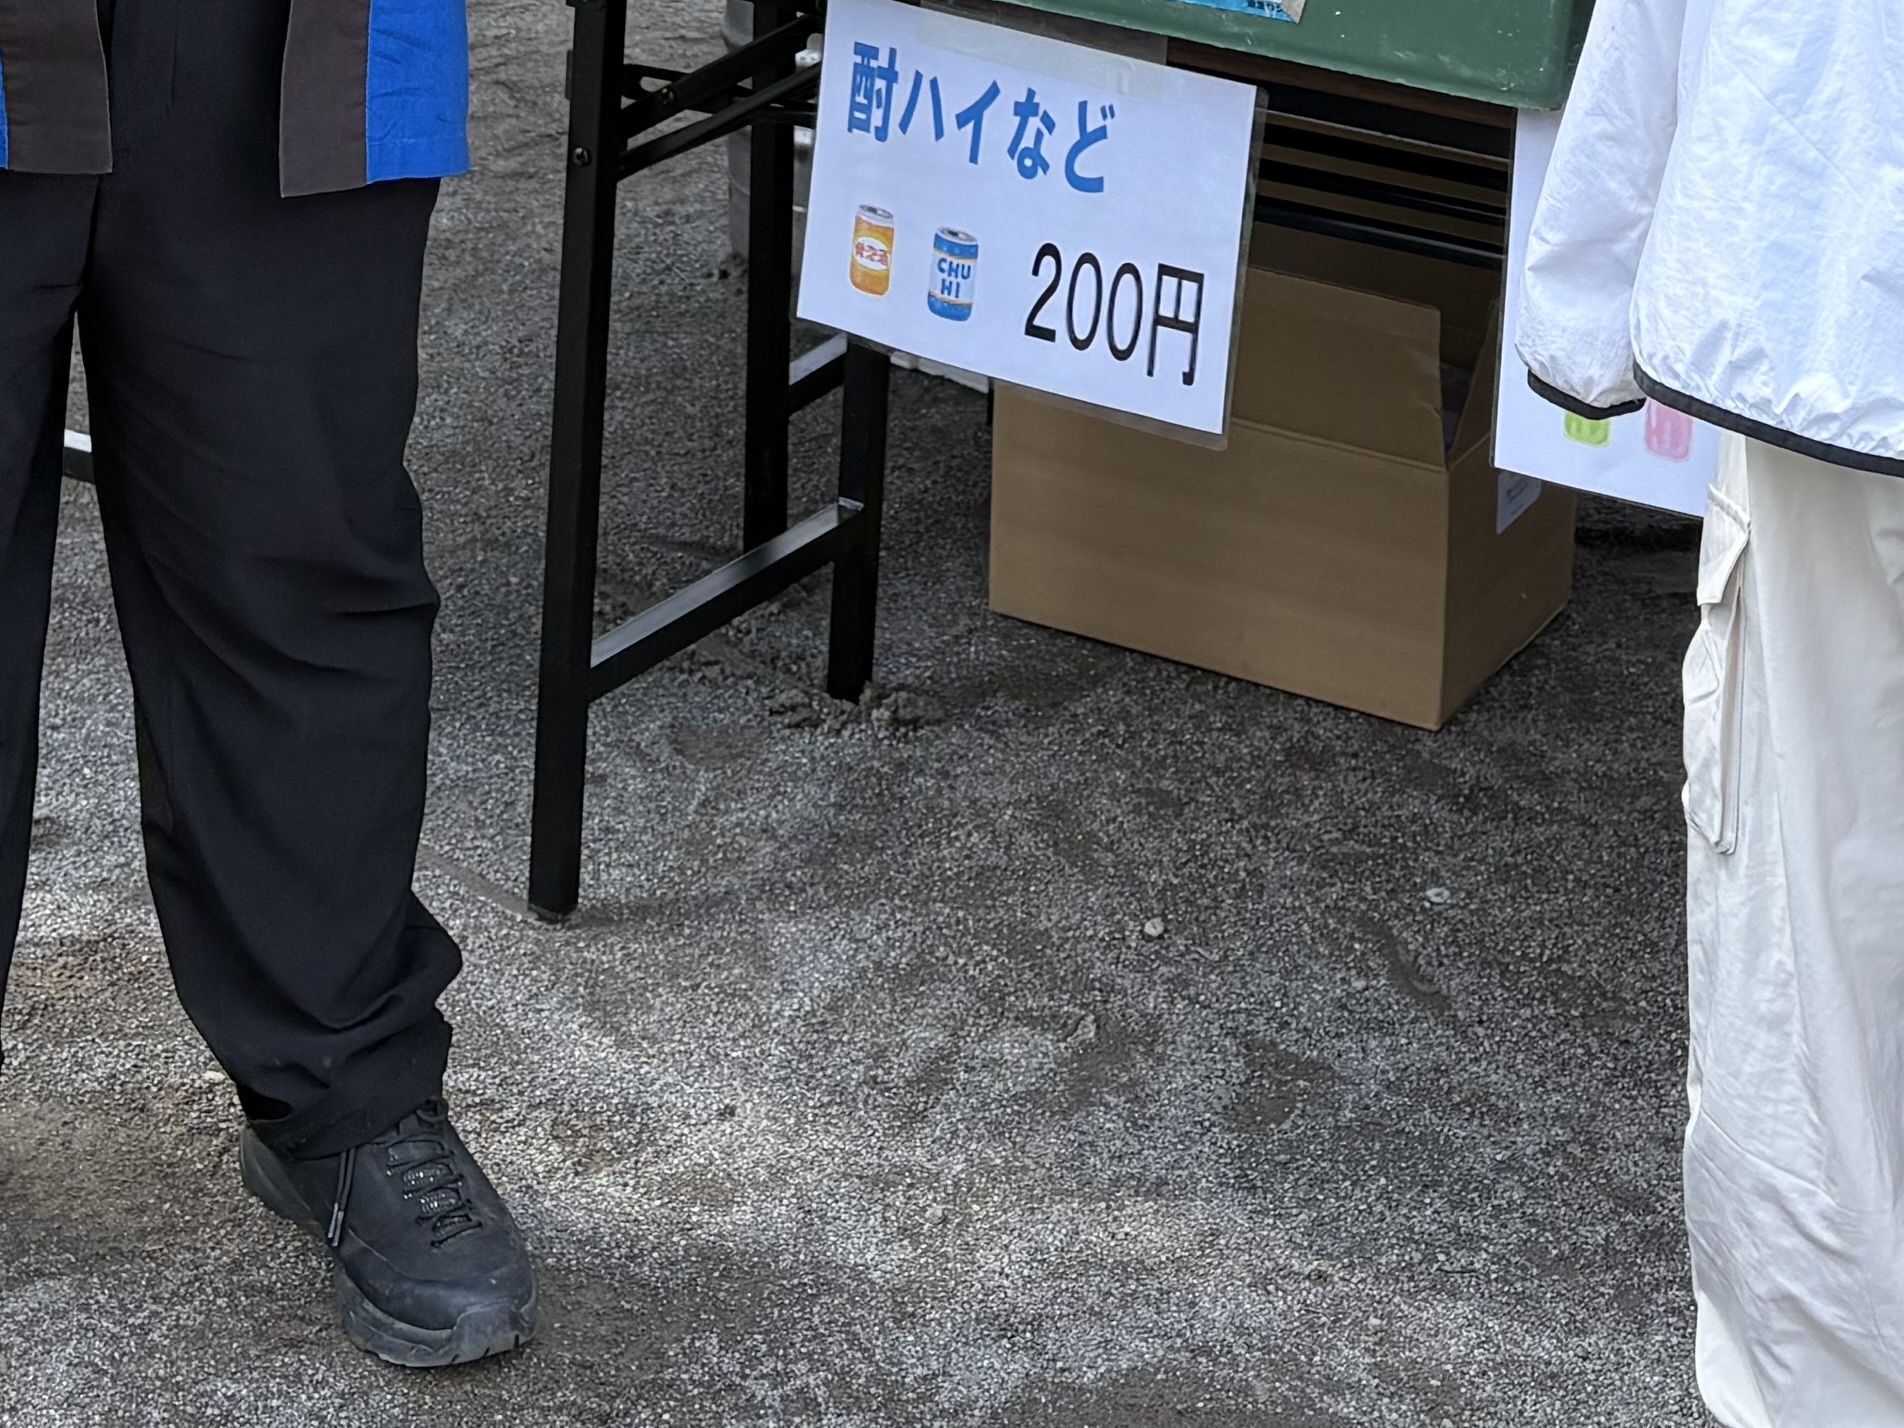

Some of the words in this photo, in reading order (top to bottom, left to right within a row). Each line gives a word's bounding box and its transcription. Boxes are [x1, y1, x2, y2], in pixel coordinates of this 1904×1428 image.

[847, 41, 1116, 194] 酎ハイなど
[937, 257, 971, 280] CHU
[940, 278, 961, 299] HI
[1024, 242, 1205, 387] 200円
